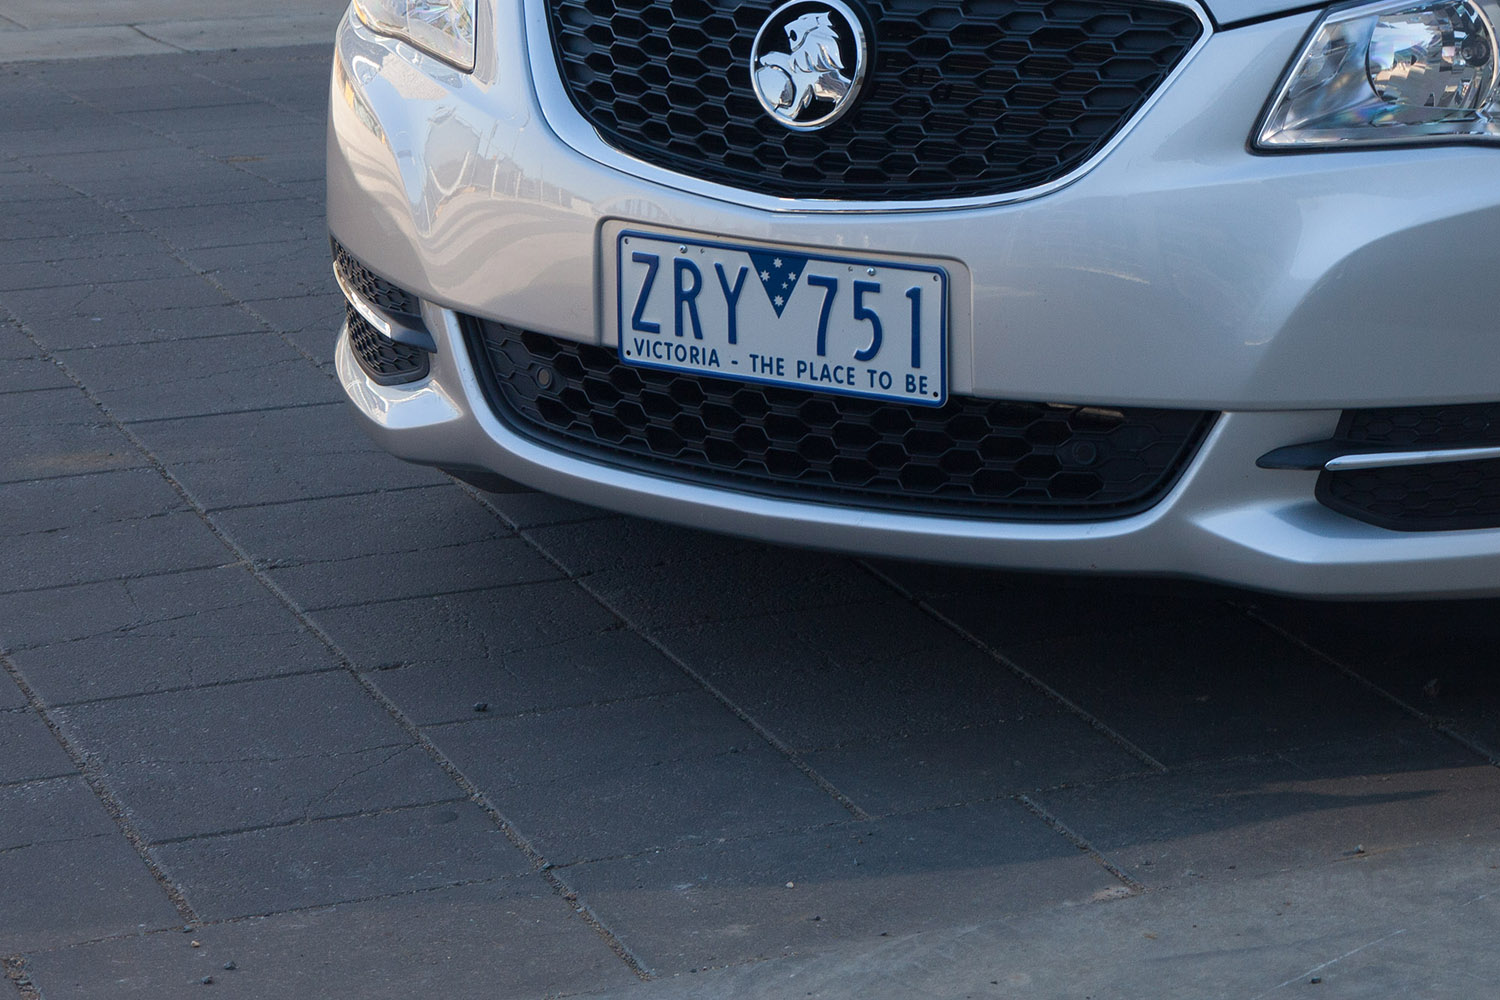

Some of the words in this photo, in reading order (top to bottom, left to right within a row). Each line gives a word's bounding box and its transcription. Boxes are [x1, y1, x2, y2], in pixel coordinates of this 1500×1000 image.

[631, 252, 749, 345] ZRY
[807, 274, 921, 369] 751
[634, 338, 720, 368] VICTORIA
[749, 354, 785, 376] THE
[797, 360, 855, 386] PLACE
[867, 369, 892, 390] TO
[905, 374, 928, 395] BE
